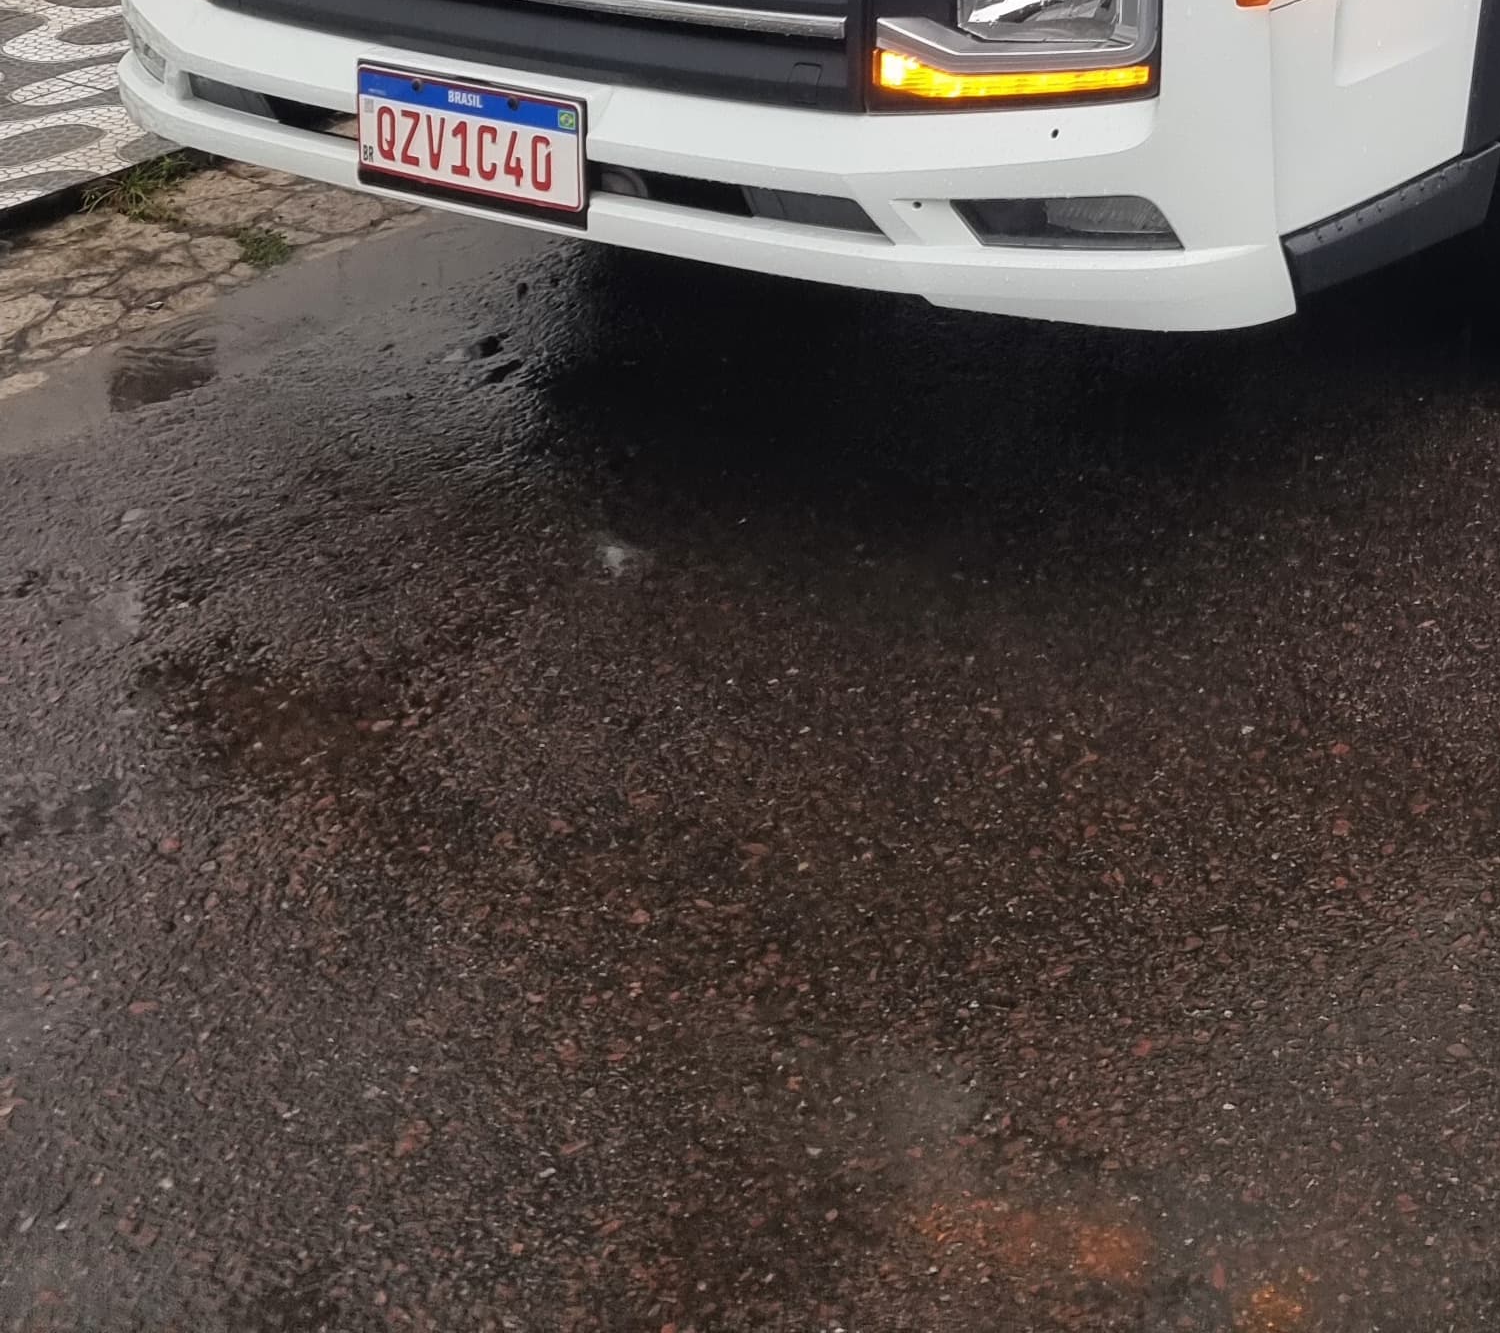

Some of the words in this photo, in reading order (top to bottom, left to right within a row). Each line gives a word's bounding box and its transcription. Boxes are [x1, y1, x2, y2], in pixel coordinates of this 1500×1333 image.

[448, 90, 483, 109] BRASIL
[363, 144, 374, 163] BR
[376, 105, 552, 192] QZV1C40
